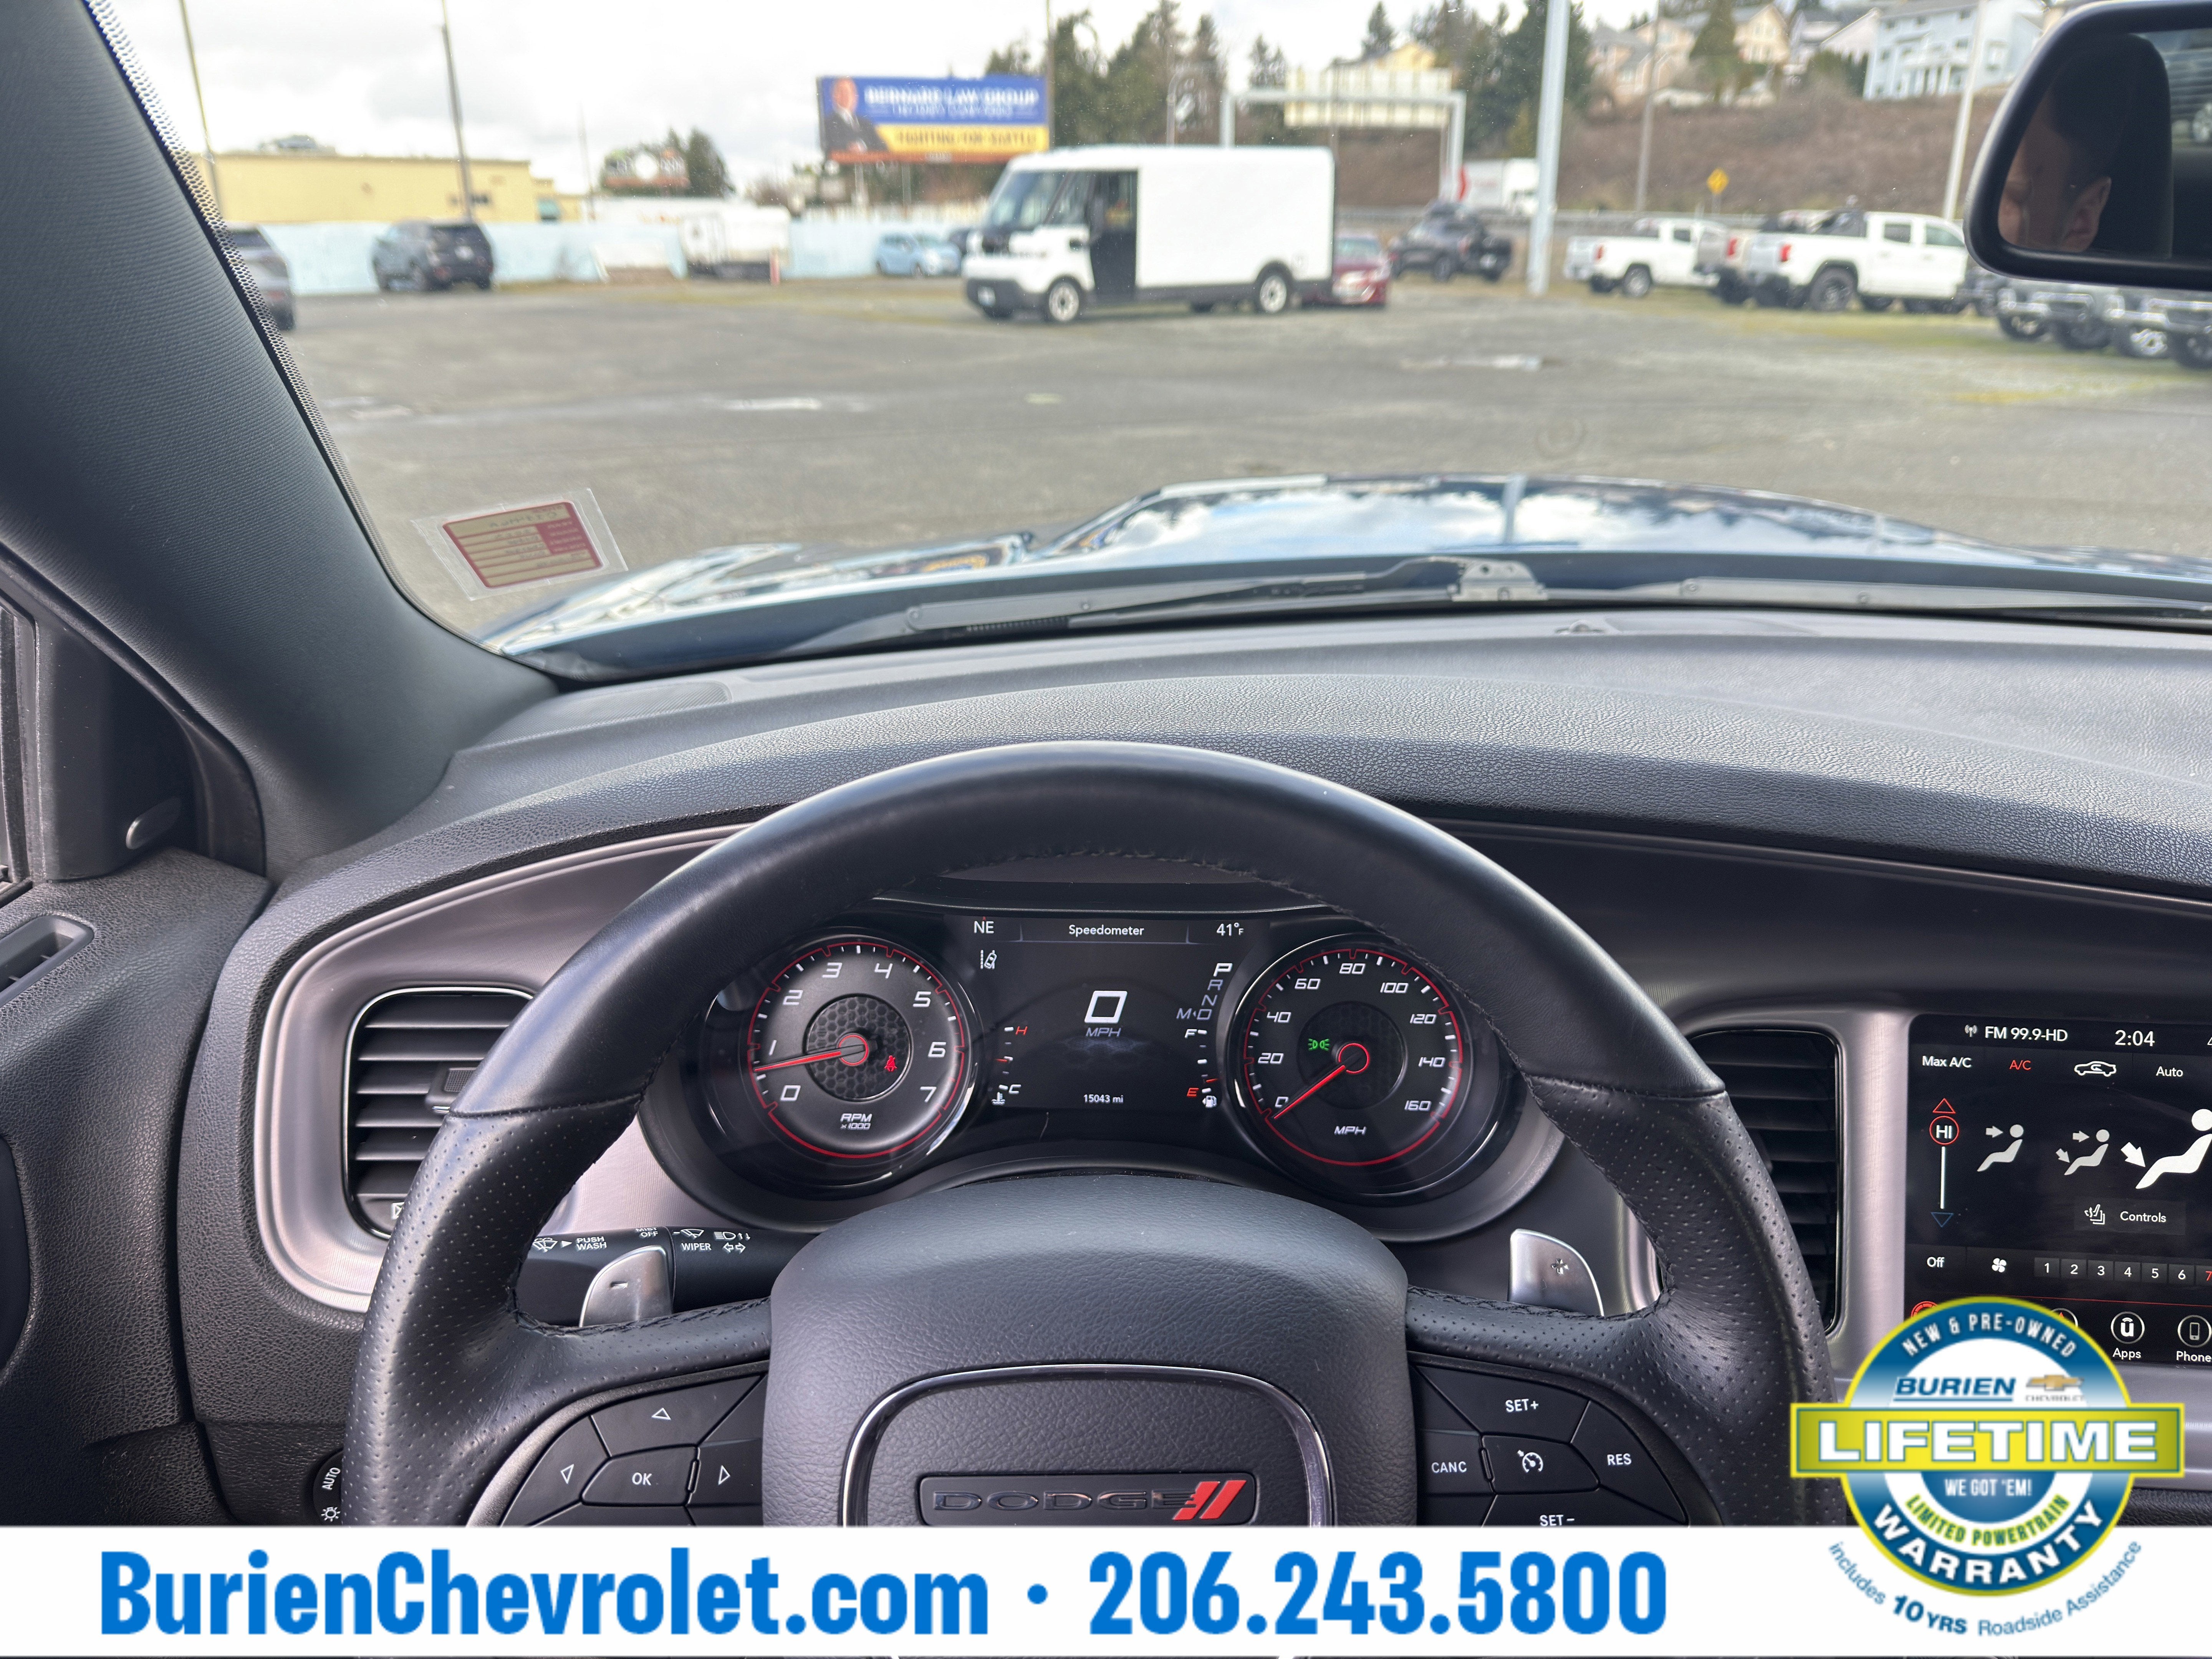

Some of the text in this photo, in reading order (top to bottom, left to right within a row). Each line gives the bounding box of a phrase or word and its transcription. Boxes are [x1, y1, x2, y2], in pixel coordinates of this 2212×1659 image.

[974, 921, 994, 934] NE
[1069, 925, 1144, 937] Speedometer
[822, 962, 842, 978] 3
[874, 963, 893, 978] 4
[1214, 963, 1232, 976] P
[1339, 963, 1366, 975] 80
[1208, 979, 1224, 990] R
[1295, 978, 1321, 990] 60
[1380, 982, 1408, 993] 100
[783, 990, 803, 1005] 2
[913, 992, 931, 1007] 5
[1202, 995, 1217, 1006] N
[1084, 990, 1128, 1023] 0
[1176, 1009, 1212, 1020] M D
[1267, 1012, 1291, 1023] 40
[1410, 1014, 1436, 1025] 120
[1016, 1026, 1028, 1035] H
[1086, 1027, 1121, 1036] MPH
[1185, 1029, 1197, 1038] F
[1985, 1026, 2068, 1042] FM 99.9-HD
[2115, 1030, 2155, 1046] 2:04
[769, 1040, 777, 1055] 1
[928, 1042, 946, 1057] 6
[1258, 1053, 1284, 1064] 20
[1418, 1057, 1445, 1068] 140
[1922, 1056, 1972, 1068] Max A/C
[2009, 1060, 2032, 1071] A/C
[2156, 1066, 2184, 1077] Auto
[780, 1085, 801, 1101] 0
[921, 1086, 937, 1103] 7
[1009, 1084, 1021, 1094] C
[1187, 1088, 1199, 1097] E
[1083, 1094, 1124, 1104] 15043 mi
[1404, 1100, 1431, 1111] 160
[840, 1113, 873, 1122] RPM
[1334, 1126, 1366, 1135] MPH
[1936, 1125, 1952, 1139] HI
[2120, 1211, 2167, 1223] Controls
[576, 1242, 607, 1250] WASH
[682, 1242, 712, 1251] WIPER
[1927, 1257, 1944, 1268] Off
[2044, 1263, 2050, 1273] 1
[2070, 1264, 2078, 1275] 2
[2097, 1266, 2105, 1276] 3
[2124, 1267, 2132, 1277] 4
[2151, 1268, 2159, 1279] 5
[2178, 1270, 2186, 1280] 6
[2113, 1348, 2141, 1359] Apps
[2176, 1350, 2212, 1363] Phone
[1505, 1399, 1539, 1412] SET+
[1607, 1453, 1632, 1465] RES
[1431, 1461, 1467, 1474] CANC
[321, 1467, 341, 1490] AUTO
[631, 1472, 652, 1486] OK
[933, 1490, 1197, 1511] DODGE
